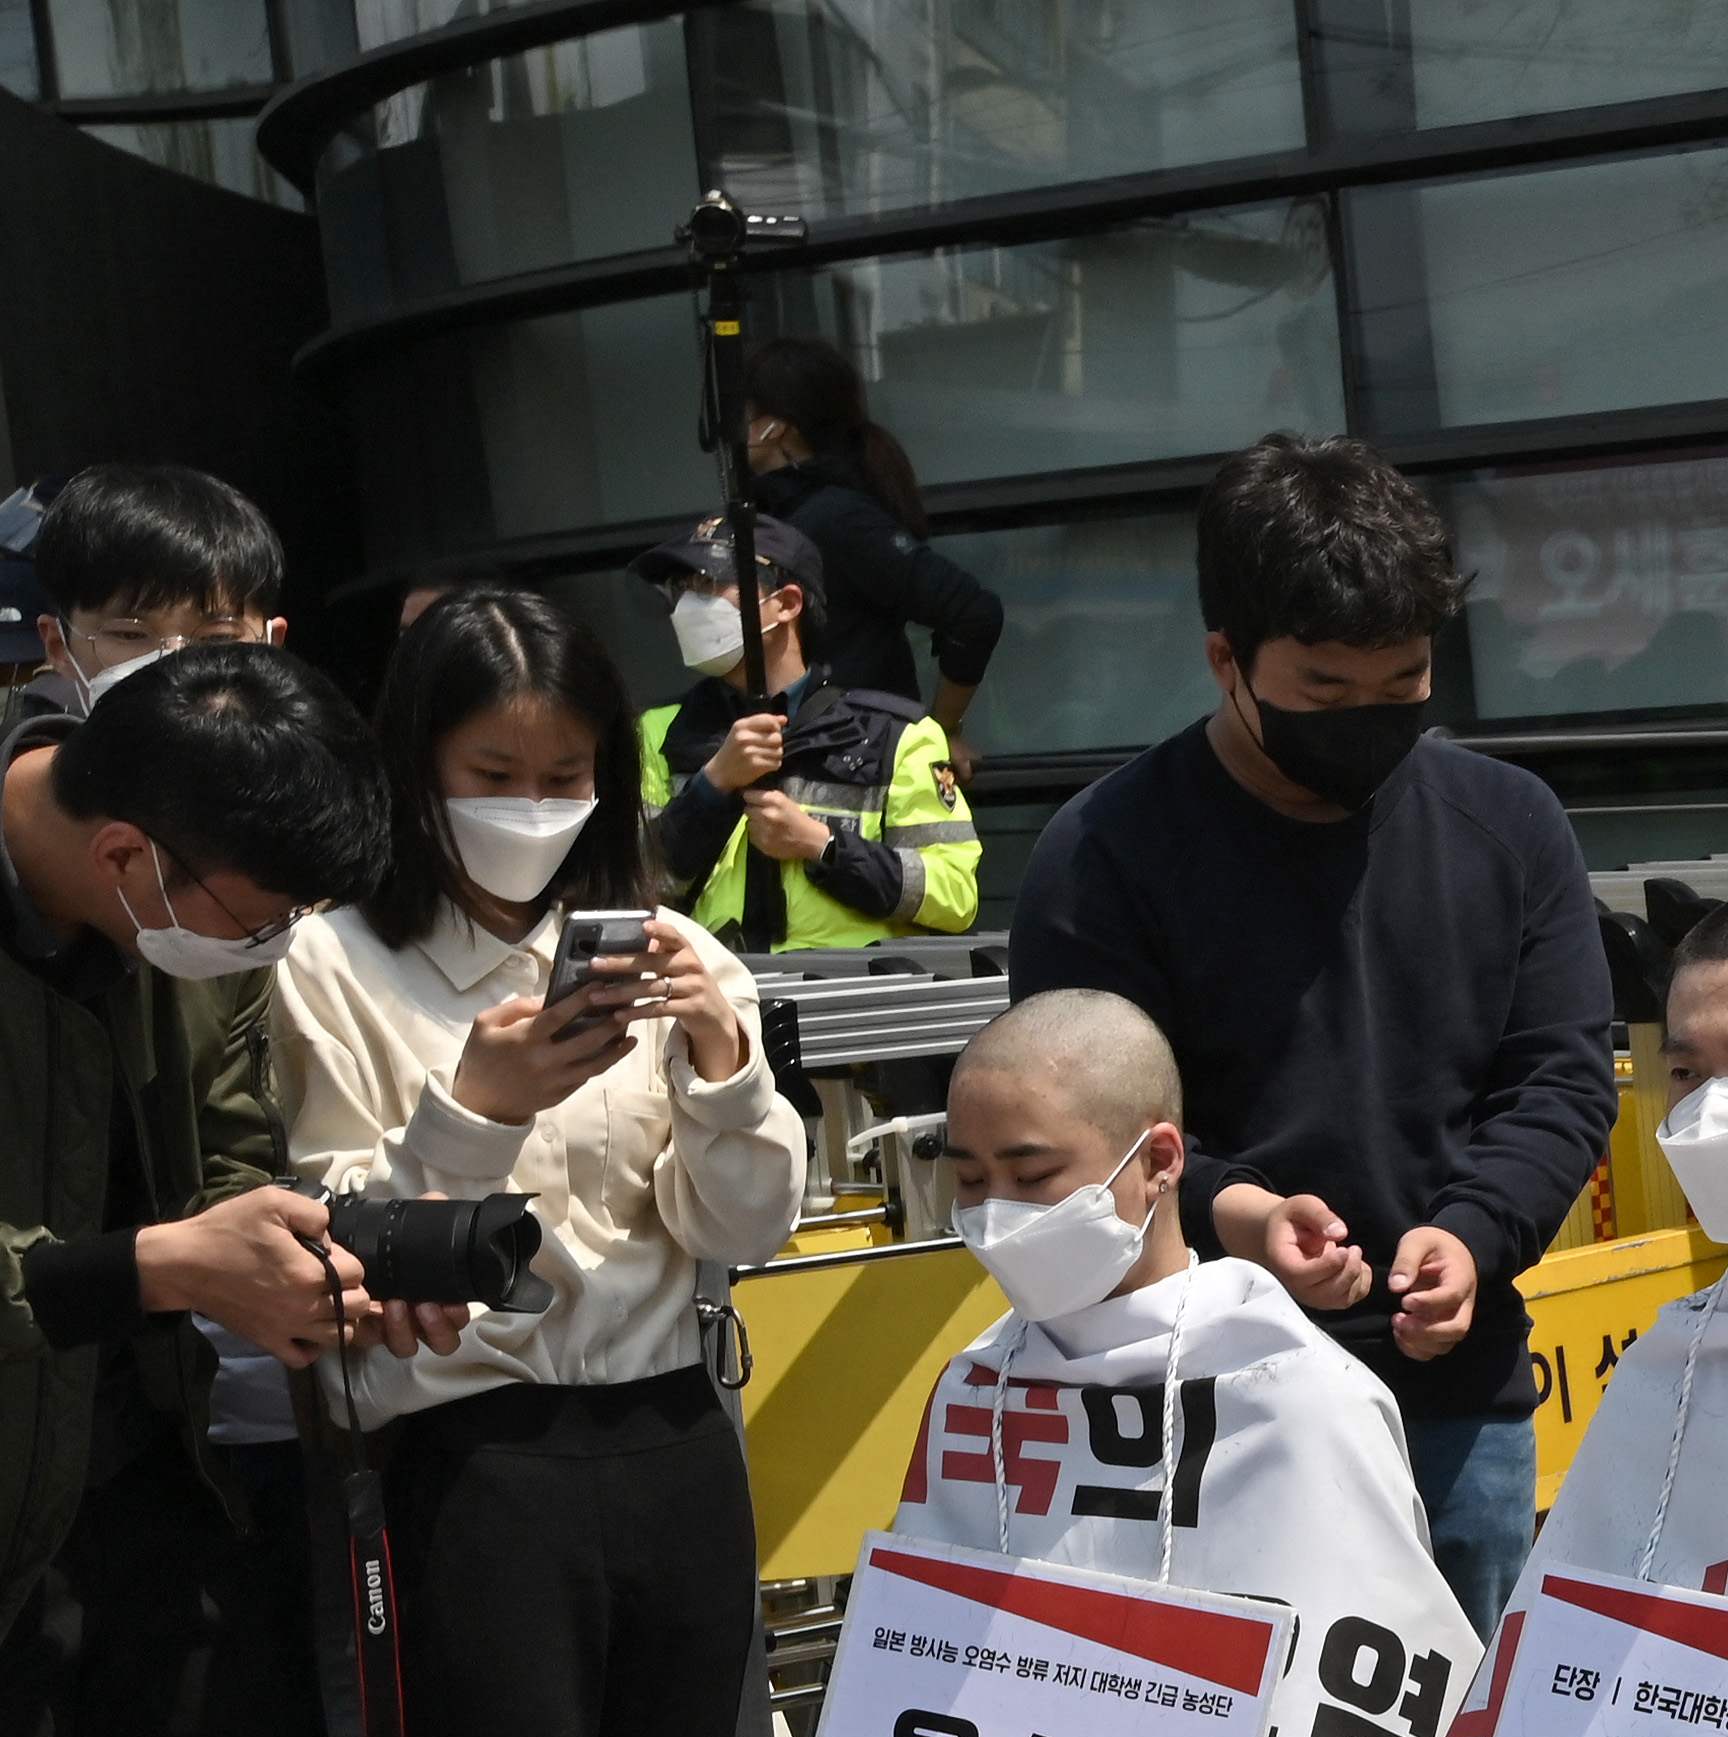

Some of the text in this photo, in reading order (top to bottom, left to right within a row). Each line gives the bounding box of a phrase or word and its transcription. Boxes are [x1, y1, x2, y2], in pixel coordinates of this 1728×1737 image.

[366, 1558, 384, 1637] Canon
[872, 1627, 1235, 1718] 일본 방사능 오염수 방류 저지 대학생 긴급 농성단
[1551, 1663, 1600, 1702] 단장
